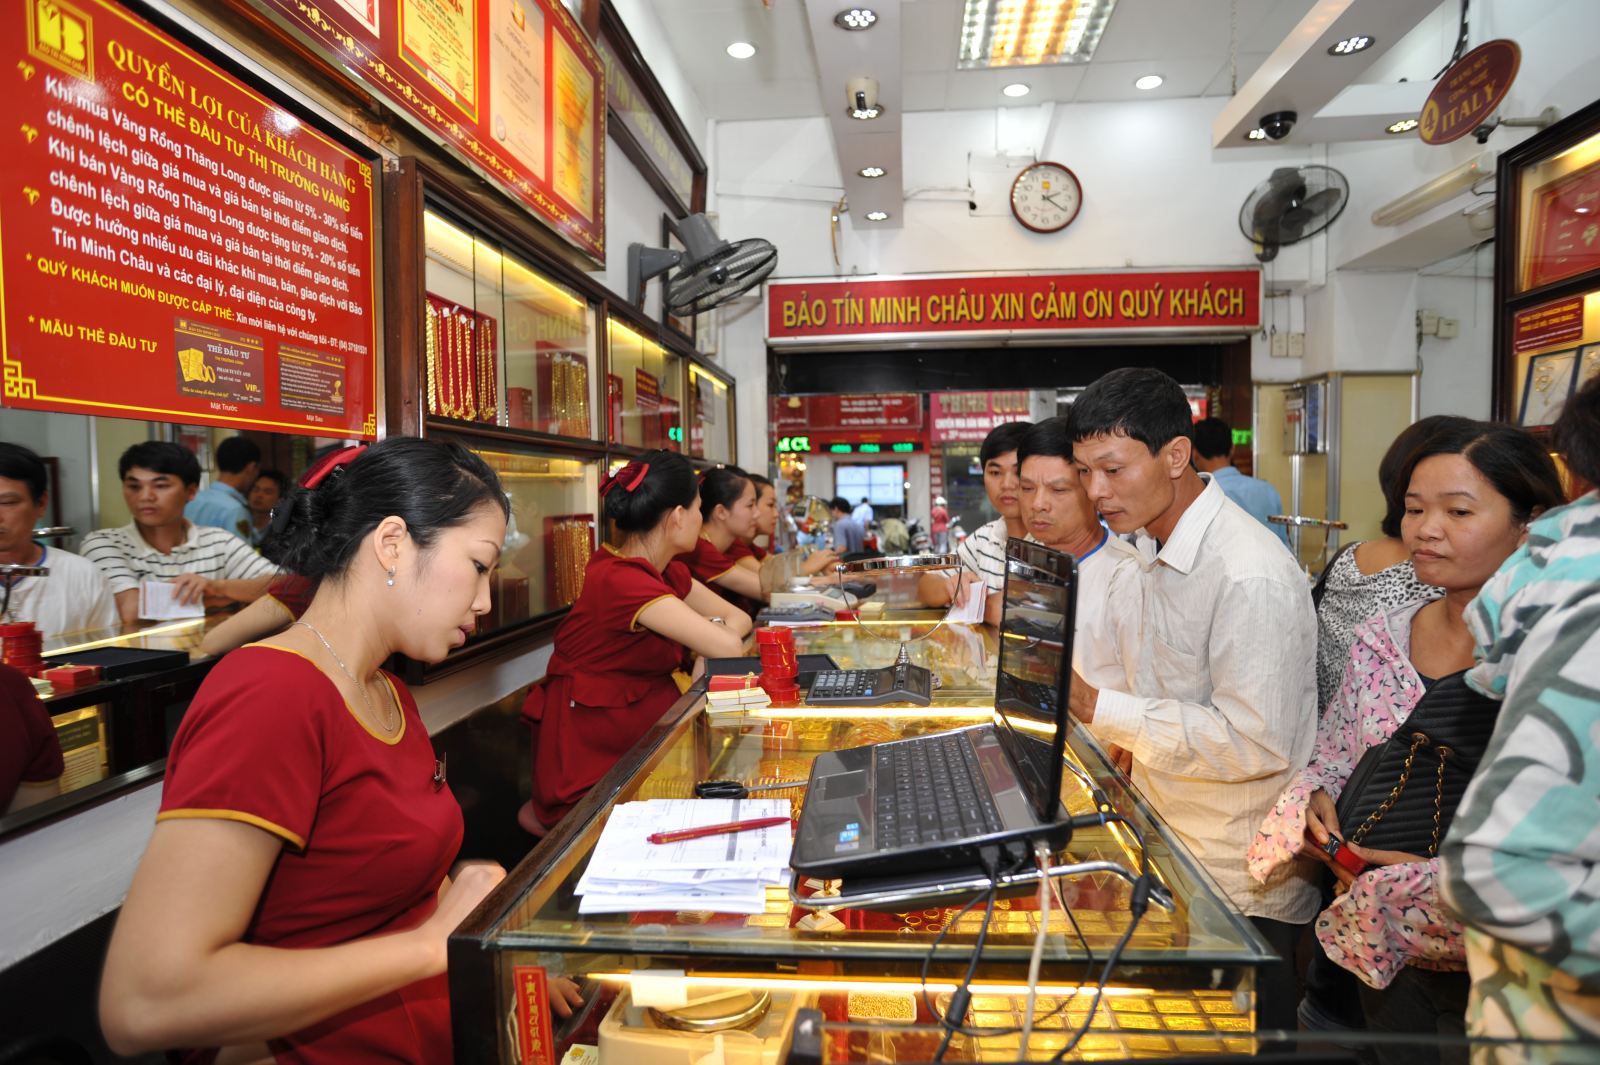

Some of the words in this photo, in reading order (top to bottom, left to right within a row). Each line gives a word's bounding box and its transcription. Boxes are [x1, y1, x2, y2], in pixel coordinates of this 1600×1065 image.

[45, 74, 73, 104] Khi
[77, 95, 109, 121] mua
[112, 107, 147, 142] Vàng
[150, 127, 181, 159] Rồng
[184, 143, 218, 176] Thăng
[220, 162, 246, 190] Long
[248, 177, 271, 199] được
[294, 200, 304, 214] từ
[304, 203, 317, 220] 5%
[322, 212, 339, 230] 30%
[340, 222, 350, 235] số
[350, 226, 363, 241] tiền
[107, 40, 184, 99] QUYỀN
[190, 86, 223, 120] LỢI
[227, 109, 262, 142] CỦA
[265, 130, 317, 173] KHÁCH
[320, 160, 356, 194] HÀNG
[122, 81, 149, 108] CÓ
[224, 135, 245, 157] TƯ
[247, 147, 268, 174] THỊ
[270, 160, 320, 197] TRƯỜNG
[321, 186, 350, 213] VÀNG
[1442, 79, 1497, 132] ITALY
[47, 110, 95, 143] chênh
[98, 128, 128, 157] lệch
[131, 149, 159, 171] giữa
[162, 162, 180, 180] giá
[182, 171, 206, 192] mua
[209, 183, 222, 198] và
[224, 190, 240, 206] giá
[241, 195, 259, 215] bán
[261, 205, 272, 222] tại
[273, 210, 290, 228] thời
[291, 219, 311, 238] điểm
[313, 230, 329, 245] giao
[330, 237, 349, 253] dịch.
[48, 135, 75, 163] Khi
[79, 149, 107, 176] bán
[110, 161, 145, 195] Vàng
[147, 178, 180, 209] Rồng
[182, 193, 217, 223] Thăng
[219, 208, 245, 234] Long
[246, 221, 270, 242] được
[271, 231, 290, 253] tặng
[291, 240, 301, 254] từ
[301, 243, 314, 260] 5%
[319, 251, 337, 269] 20%
[337, 259, 347, 272] số
[347, 263, 361, 277] tiền
[49, 170, 97, 200] chênh
[101, 186, 130, 212] lệch
[133, 202, 160, 223] giữa
[163, 213, 181, 231] giá
[184, 221, 208, 241] mua
[210, 231, 223, 246] và
[225, 237, 241, 252] giá
[242, 241, 260, 260] bán
[261, 249, 273, 267] tại
[274, 253, 291, 271] thời
[292, 260, 313, 279] điểm
[313, 271, 331, 285] giao
[331, 277, 350, 292] dịch.
[37, 257, 68, 278] QUÝ
[71, 266, 118, 291] KHÁCH
[157, 290, 190, 310] ĐƯỢC
[236, 311, 248, 323] Xin
[248, 316, 263, 328] mời
[263, 319, 277, 332] liên
[277, 322, 286, 336] hệ
[286, 326, 298, 337] với
[298, 329, 318, 345] chúng
[50, 196, 91, 227] Được
[95, 212, 139, 246] hưởng
[142, 231, 176, 254] nhiều
[179, 244, 193, 260] ưu
[196, 249, 213, 267] đãi
[215, 254, 239, 276] khác
[241, 264, 256, 281] khi
[257, 272, 279, 290] mua,
[281, 277, 299, 297] bán,
[300, 286, 317, 301] giao
[319, 292, 336, 308] dịch
[336, 298, 348, 311] với
[348, 301, 363, 316] Bảo
[51, 226, 77, 250] Tín
[80, 236, 116, 262] Minh
[120, 249, 154, 273] Châu
[156, 262, 171, 279] và
[173, 268, 194, 285] các
[196, 274, 213, 293] đại
[215, 278, 228, 297] lý,
[229, 284, 245, 303] đại
[246, 289, 267, 308] diện
[268, 296, 285, 312] của
[285, 302, 306, 321] công
[307, 308, 318, 324] ty.
[783, 290, 827, 327] BẢO
[832, 291, 864, 325] TÍN
[870, 295, 921, 324] MINH
[926, 288, 985, 323] CHÂU
[991, 293, 1024, 320] XIN
[1030, 282, 1076, 319] CẢM
[1082, 288, 1113, 318] ƠN
[1119, 282, 1164, 319] QUÝ
[1169, 281, 1244, 316] KHÁCH
[39, 317, 73, 338] MẪU
[139, 338, 158, 353] TƯ
